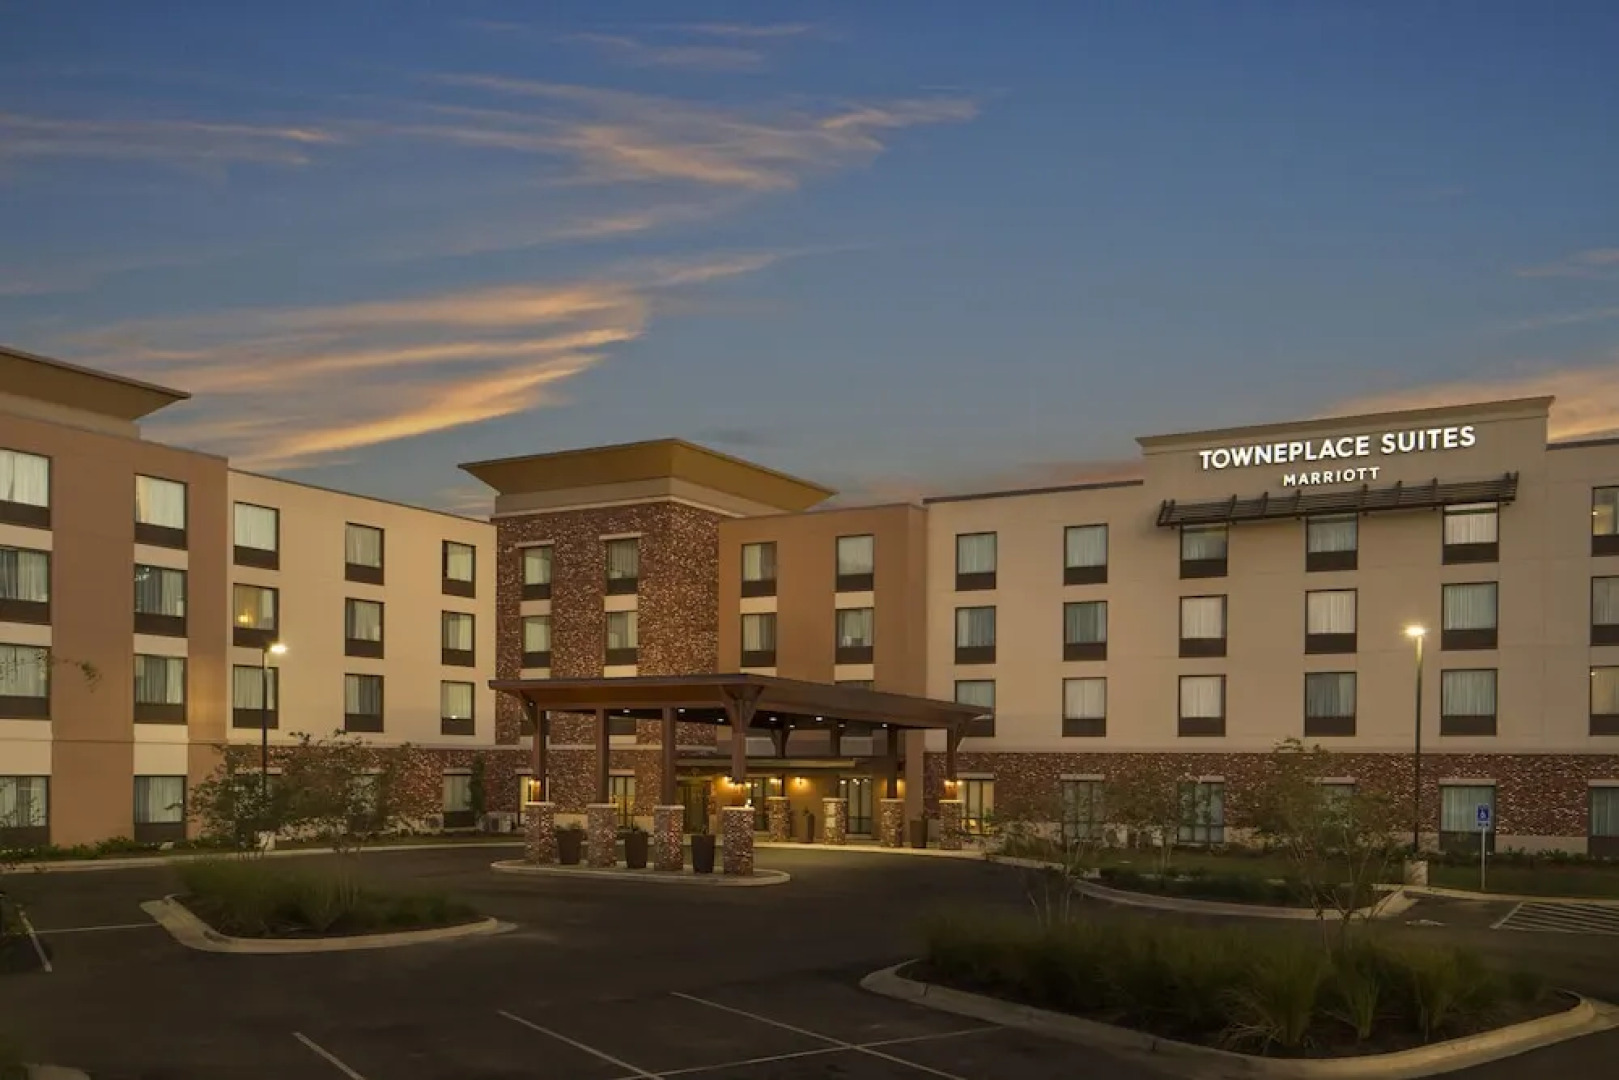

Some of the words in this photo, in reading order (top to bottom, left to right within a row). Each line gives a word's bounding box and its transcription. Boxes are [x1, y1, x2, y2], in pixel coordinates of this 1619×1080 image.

[1199, 435, 1370, 469] TOWNEPLACE
[1381, 425, 1476, 454] SUITES
[1283, 467, 1380, 487] MARRIOTT
